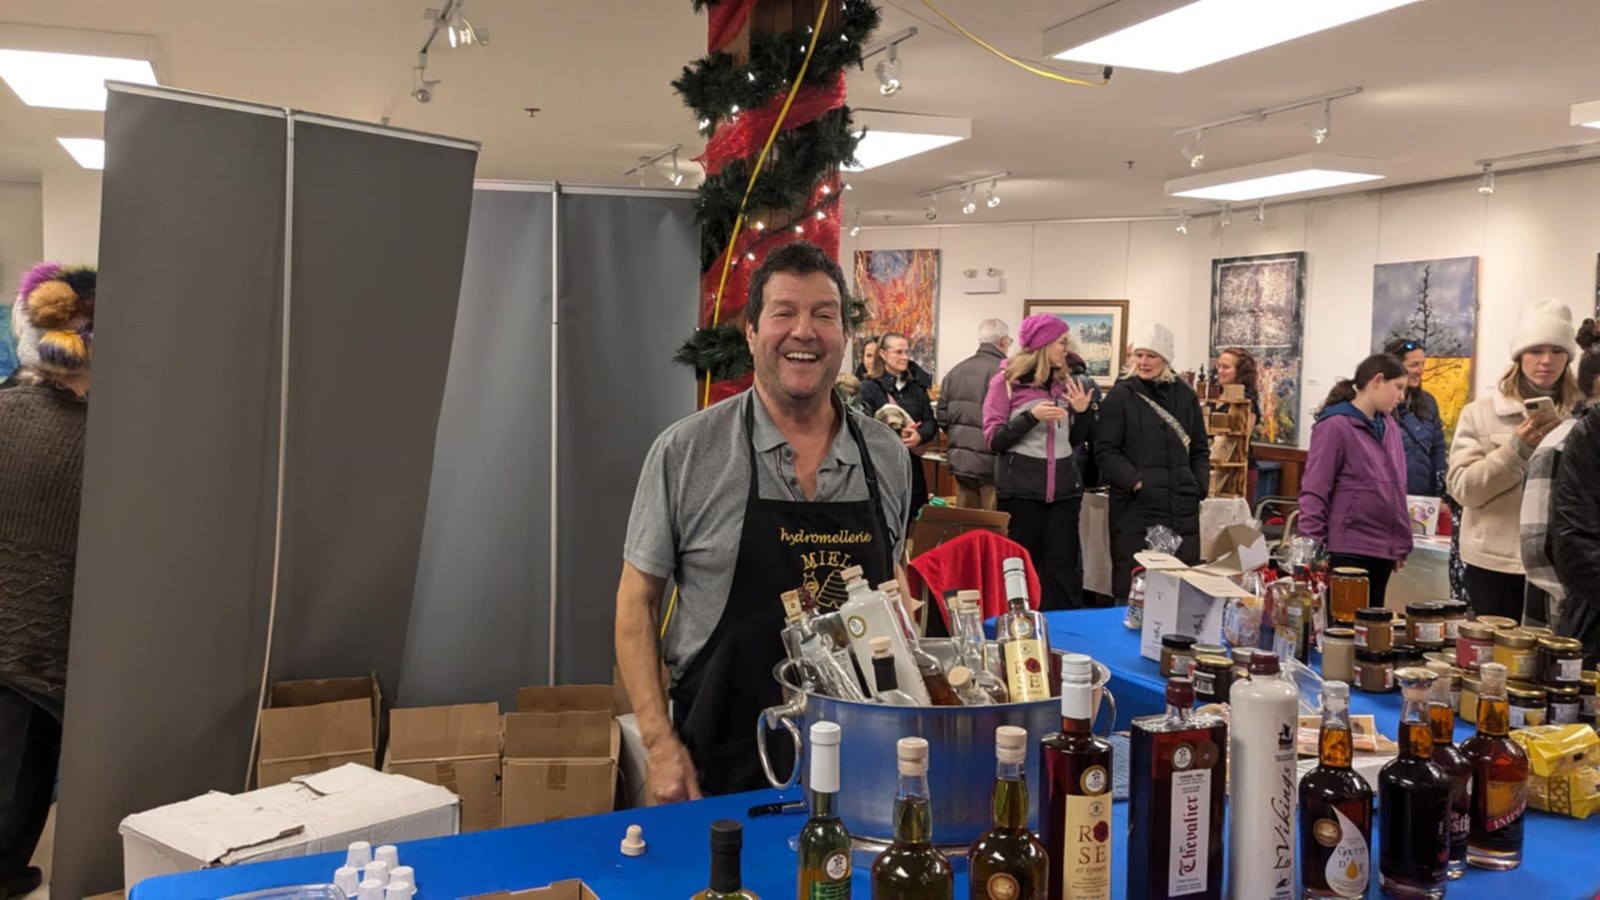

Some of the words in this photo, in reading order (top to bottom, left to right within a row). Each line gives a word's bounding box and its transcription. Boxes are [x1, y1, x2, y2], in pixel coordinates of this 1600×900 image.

[779, 527, 872, 546] hydromellerie
[801, 550, 852, 570] MIEL
[1179, 795, 1199, 876] Chevalier
[1270, 765, 1297, 857] Vikings
